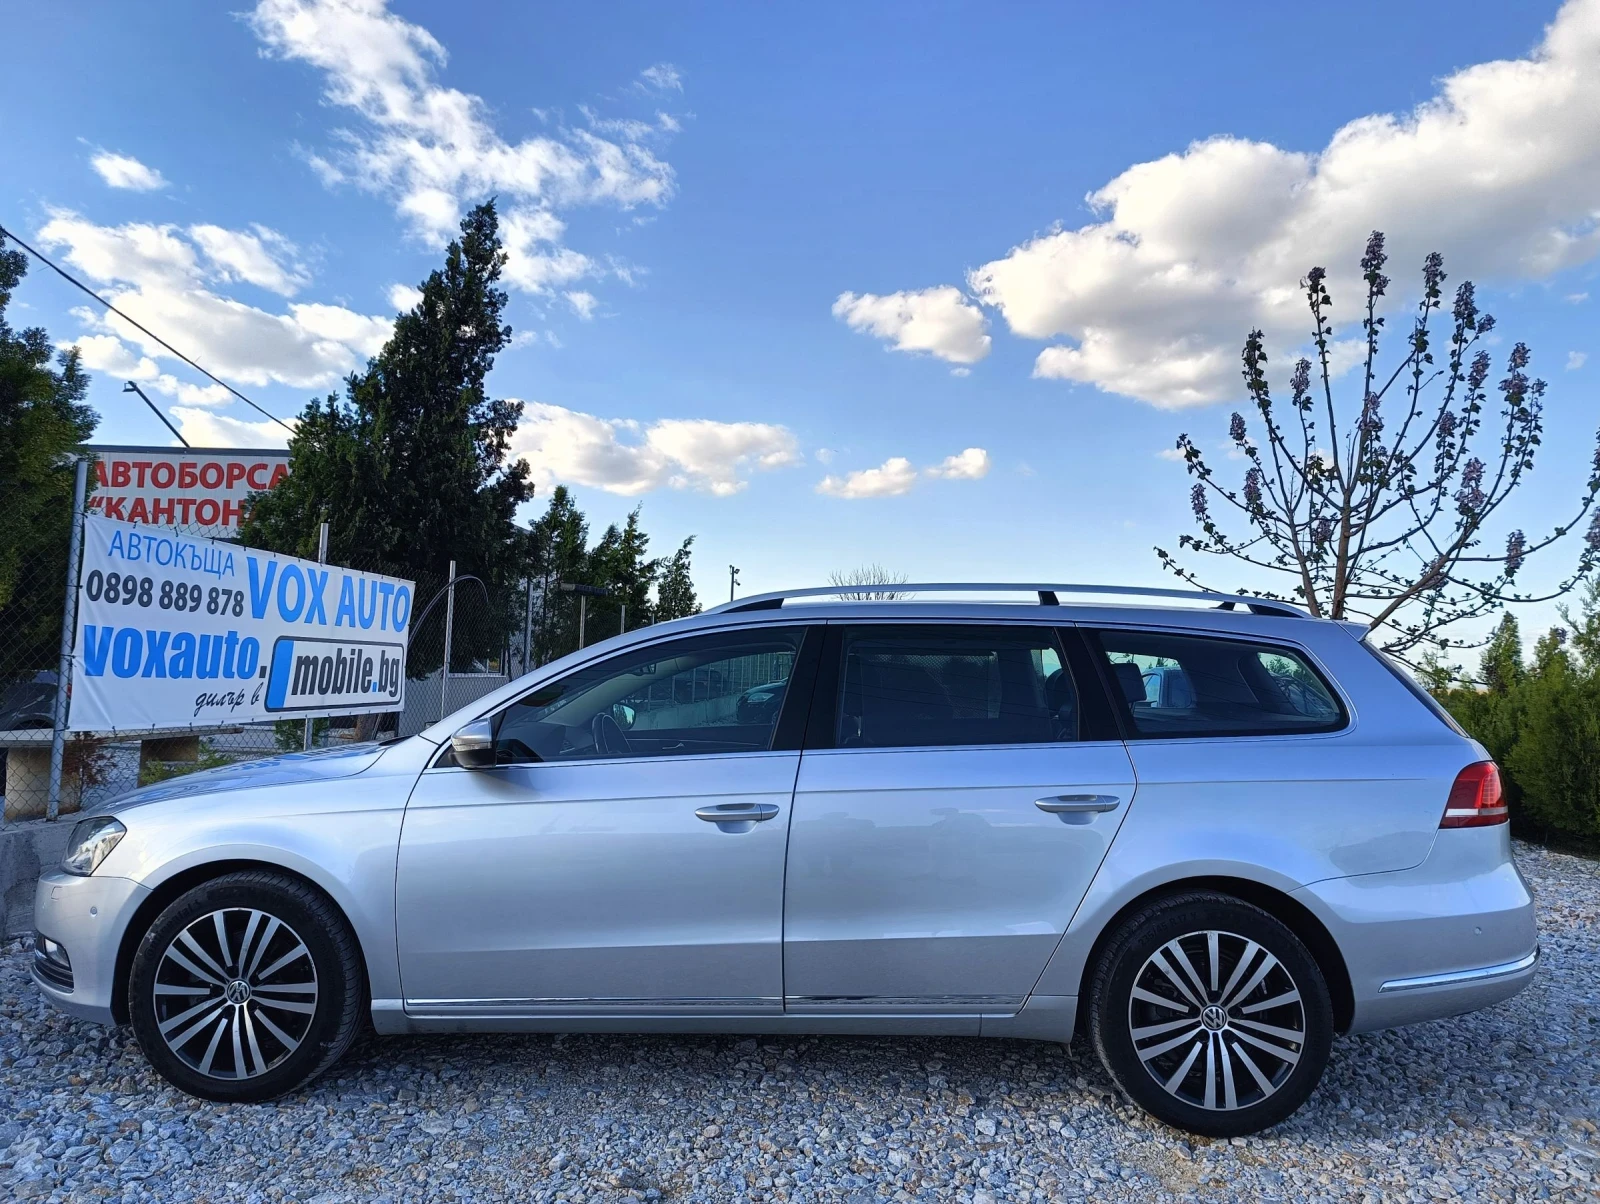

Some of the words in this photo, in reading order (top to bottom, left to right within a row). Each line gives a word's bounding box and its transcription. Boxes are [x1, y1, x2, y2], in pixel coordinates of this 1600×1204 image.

[94, 460, 290, 490] АВТОБОРСА
[88, 496, 257, 527] “КАНТОН
[108, 530, 235, 580] АВТОКЪЩА
[86, 569, 154, 608] 0898
[158, 580, 203, 613] 889
[206, 586, 245, 617] 878
[246, 556, 329, 626] VOX
[335, 575, 411, 633] AUTO
[291, 647, 401, 698] mobile.bg
[194, 688, 245, 717] дилър
